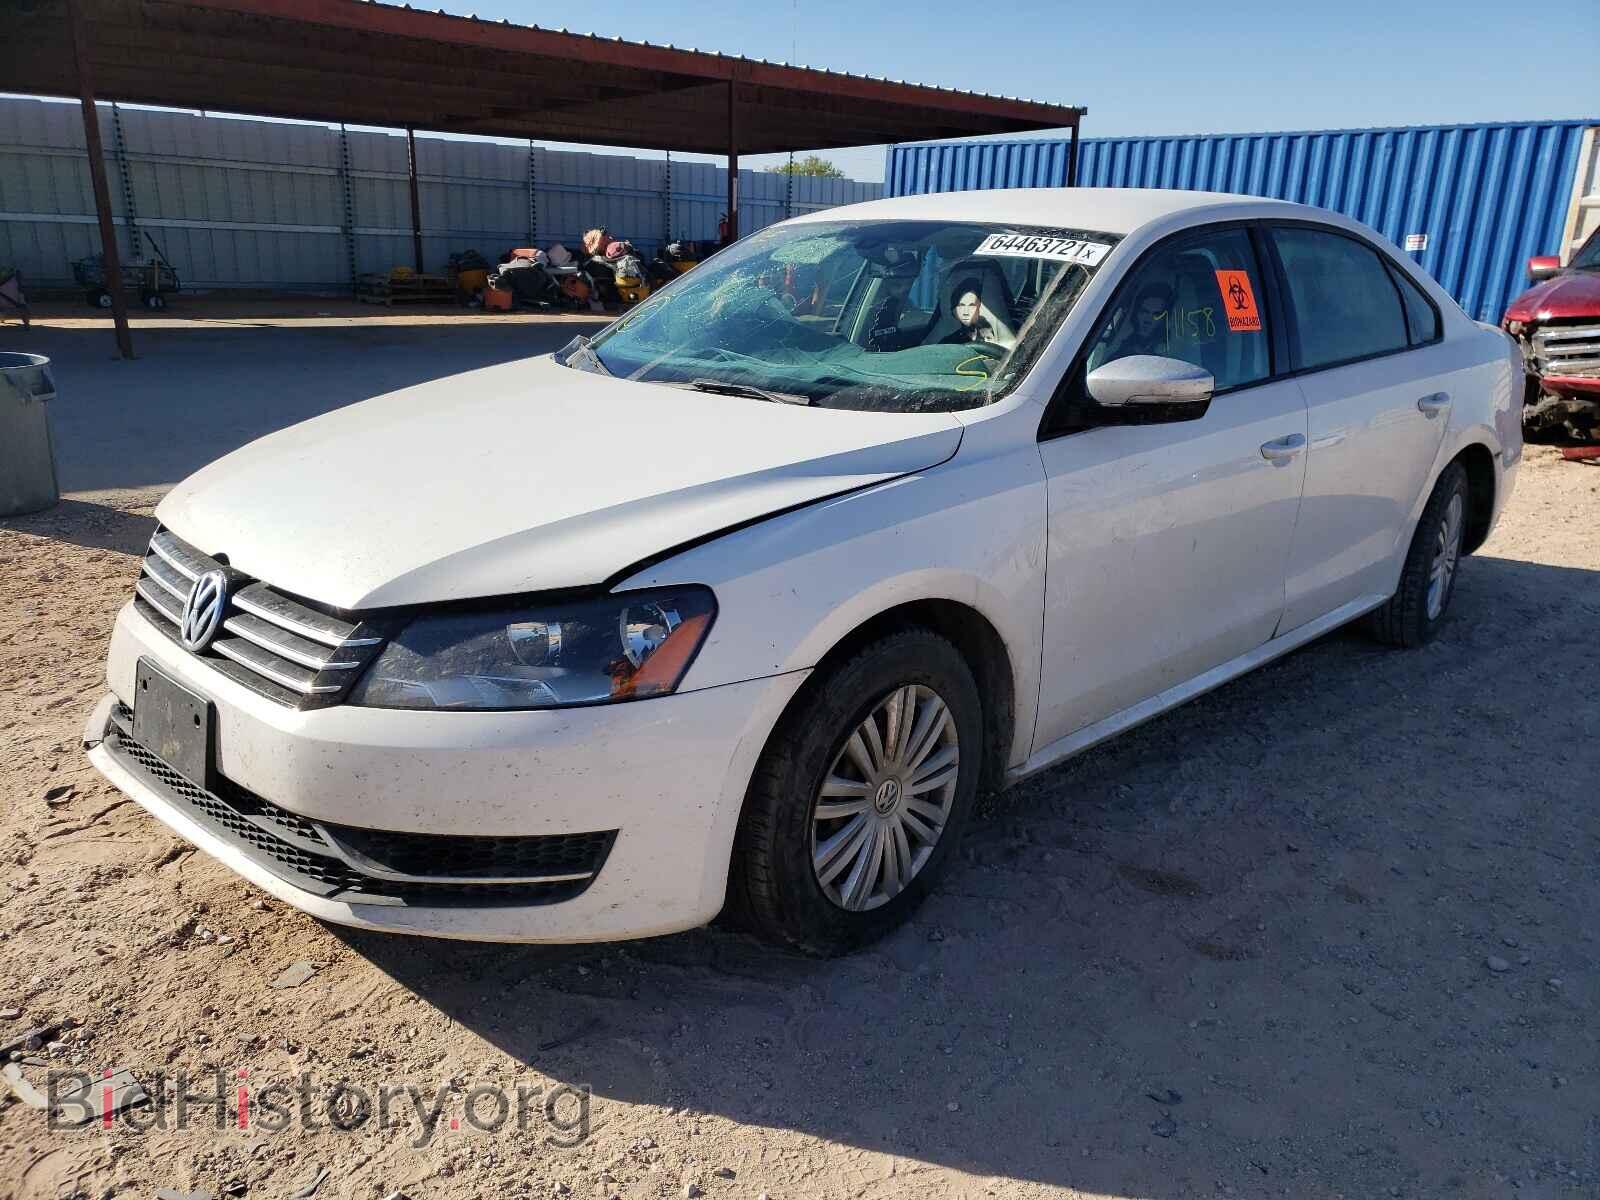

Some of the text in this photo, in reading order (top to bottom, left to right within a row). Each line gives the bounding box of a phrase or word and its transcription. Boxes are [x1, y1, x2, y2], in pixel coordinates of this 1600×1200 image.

[990, 235, 1087, 257] 64463721
[1230, 315, 1260, 327] BIOHAZARD
[181, 569, 227, 652] VW
